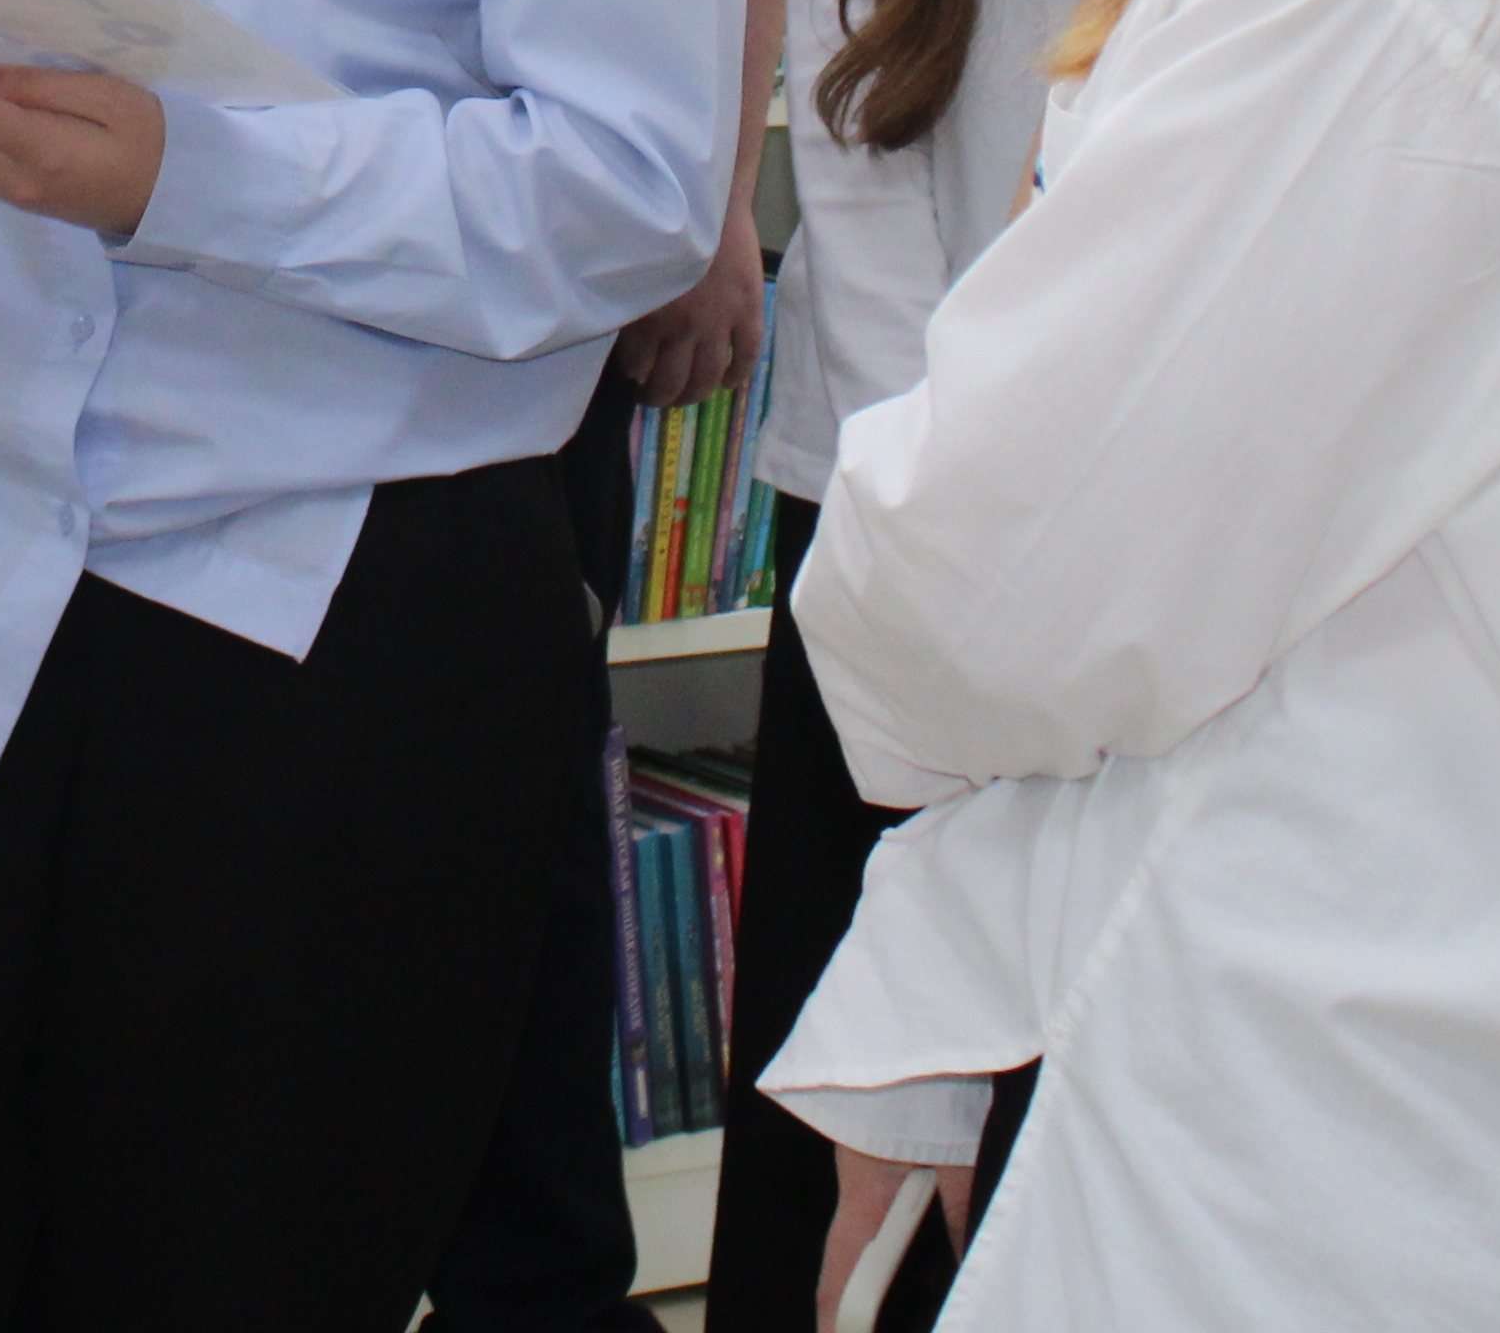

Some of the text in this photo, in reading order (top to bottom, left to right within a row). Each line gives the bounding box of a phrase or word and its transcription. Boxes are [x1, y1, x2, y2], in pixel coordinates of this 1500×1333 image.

[610, 757, 643, 1032] НОВАЯ ДЕТСКАЯ ЭНЦИКЛОПЕДИЯ
